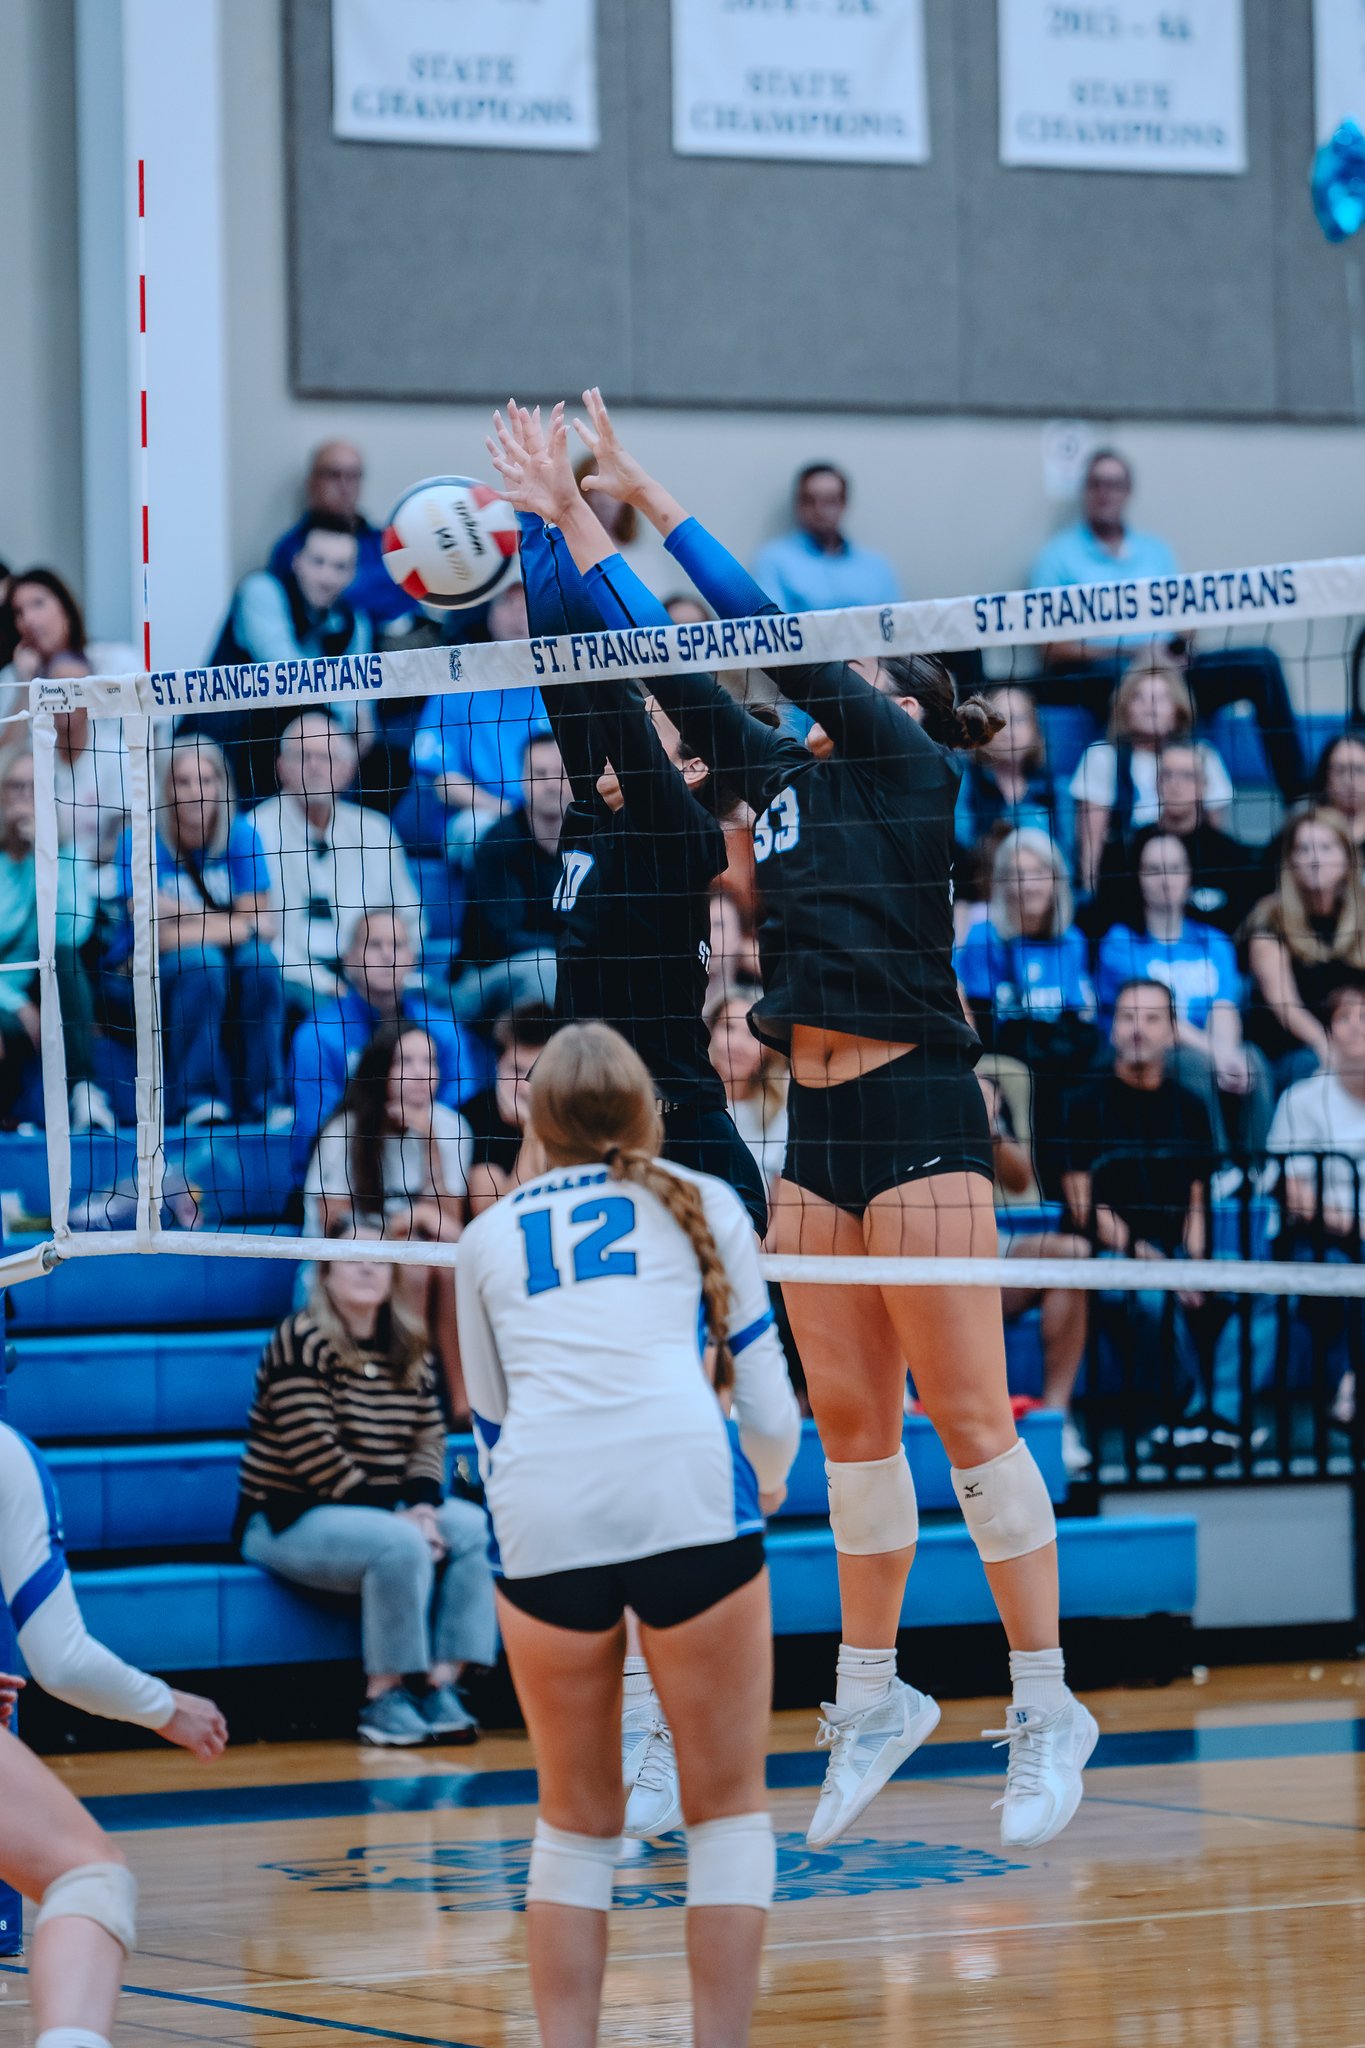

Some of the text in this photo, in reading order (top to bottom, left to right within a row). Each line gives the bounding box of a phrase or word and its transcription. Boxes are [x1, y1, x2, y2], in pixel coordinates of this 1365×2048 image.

[408, 53, 516, 84] STATE
[747, 67, 850, 98] STATE
[351, 87, 574, 124] CHAMPIONS
[690, 101, 906, 136] CHAMPIONS
[1016, 111, 1225, 148] CHAMPIONS
[974, 568, 1297, 632] ST. FRANCIS SPARTANS
[530, 617, 804, 674] ST. FRANCIS SPARTANS
[150, 654, 383, 705] ST. FRANCIS SPARTANS
[519, 1196, 637, 1296] 12
